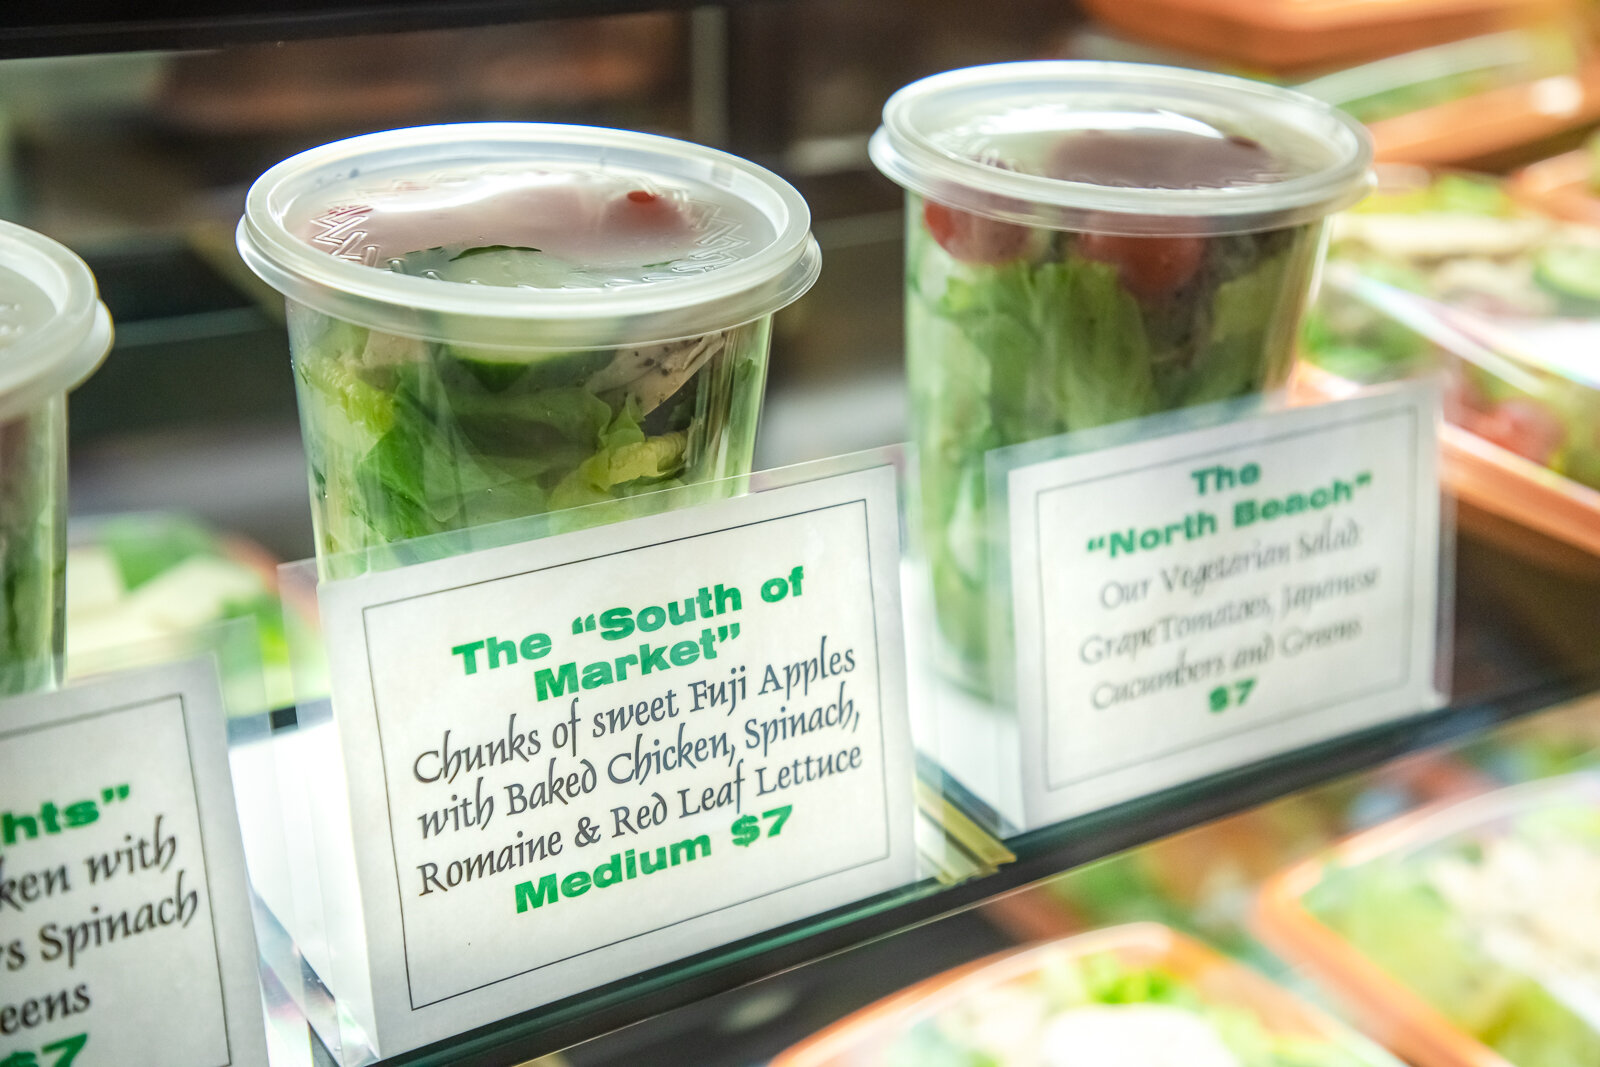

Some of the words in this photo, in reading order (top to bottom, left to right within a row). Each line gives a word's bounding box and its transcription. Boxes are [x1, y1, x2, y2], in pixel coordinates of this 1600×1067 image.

[1087, 511, 1217, 558] “North
[1233, 471, 1372, 527] Beach”
[1190, 463, 1261, 496] The
[1100, 577, 1151, 610] Our
[1161, 538, 1290, 597] Vegetarian
[1280, 567, 1380, 621] Japanese
[451, 632, 552, 676] The
[571, 583, 743, 641] “South
[760, 566, 804, 603] of
[534, 623, 741, 702] Market”
[1091, 648, 1226, 711] Cucumbers
[1231, 632, 1275, 670] and
[1281, 617, 1362, 659] Greens
[413, 713, 541, 784] Chunks
[552, 697, 581, 758] of
[592, 690, 680, 738] sweet
[688, 665, 747, 717] Fuji
[757, 635, 857, 701] Apples
[1208, 677, 1258, 713] $7
[418, 777, 494, 840] with
[504, 757, 598, 817] Baked
[607, 722, 736, 786] Chicken,
[744, 681, 861, 752] Spinach,
[84, 814, 177, 886] with
[417, 830, 563, 897] Romaine
[573, 816, 602, 848] &
[610, 792, 668, 838] Red
[678, 759, 744, 815] Leaf
[755, 743, 863, 797] Lettuce
[513, 833, 712, 915] Medium
[730, 804, 793, 848] $7
[38, 869, 198, 969] Spinach
